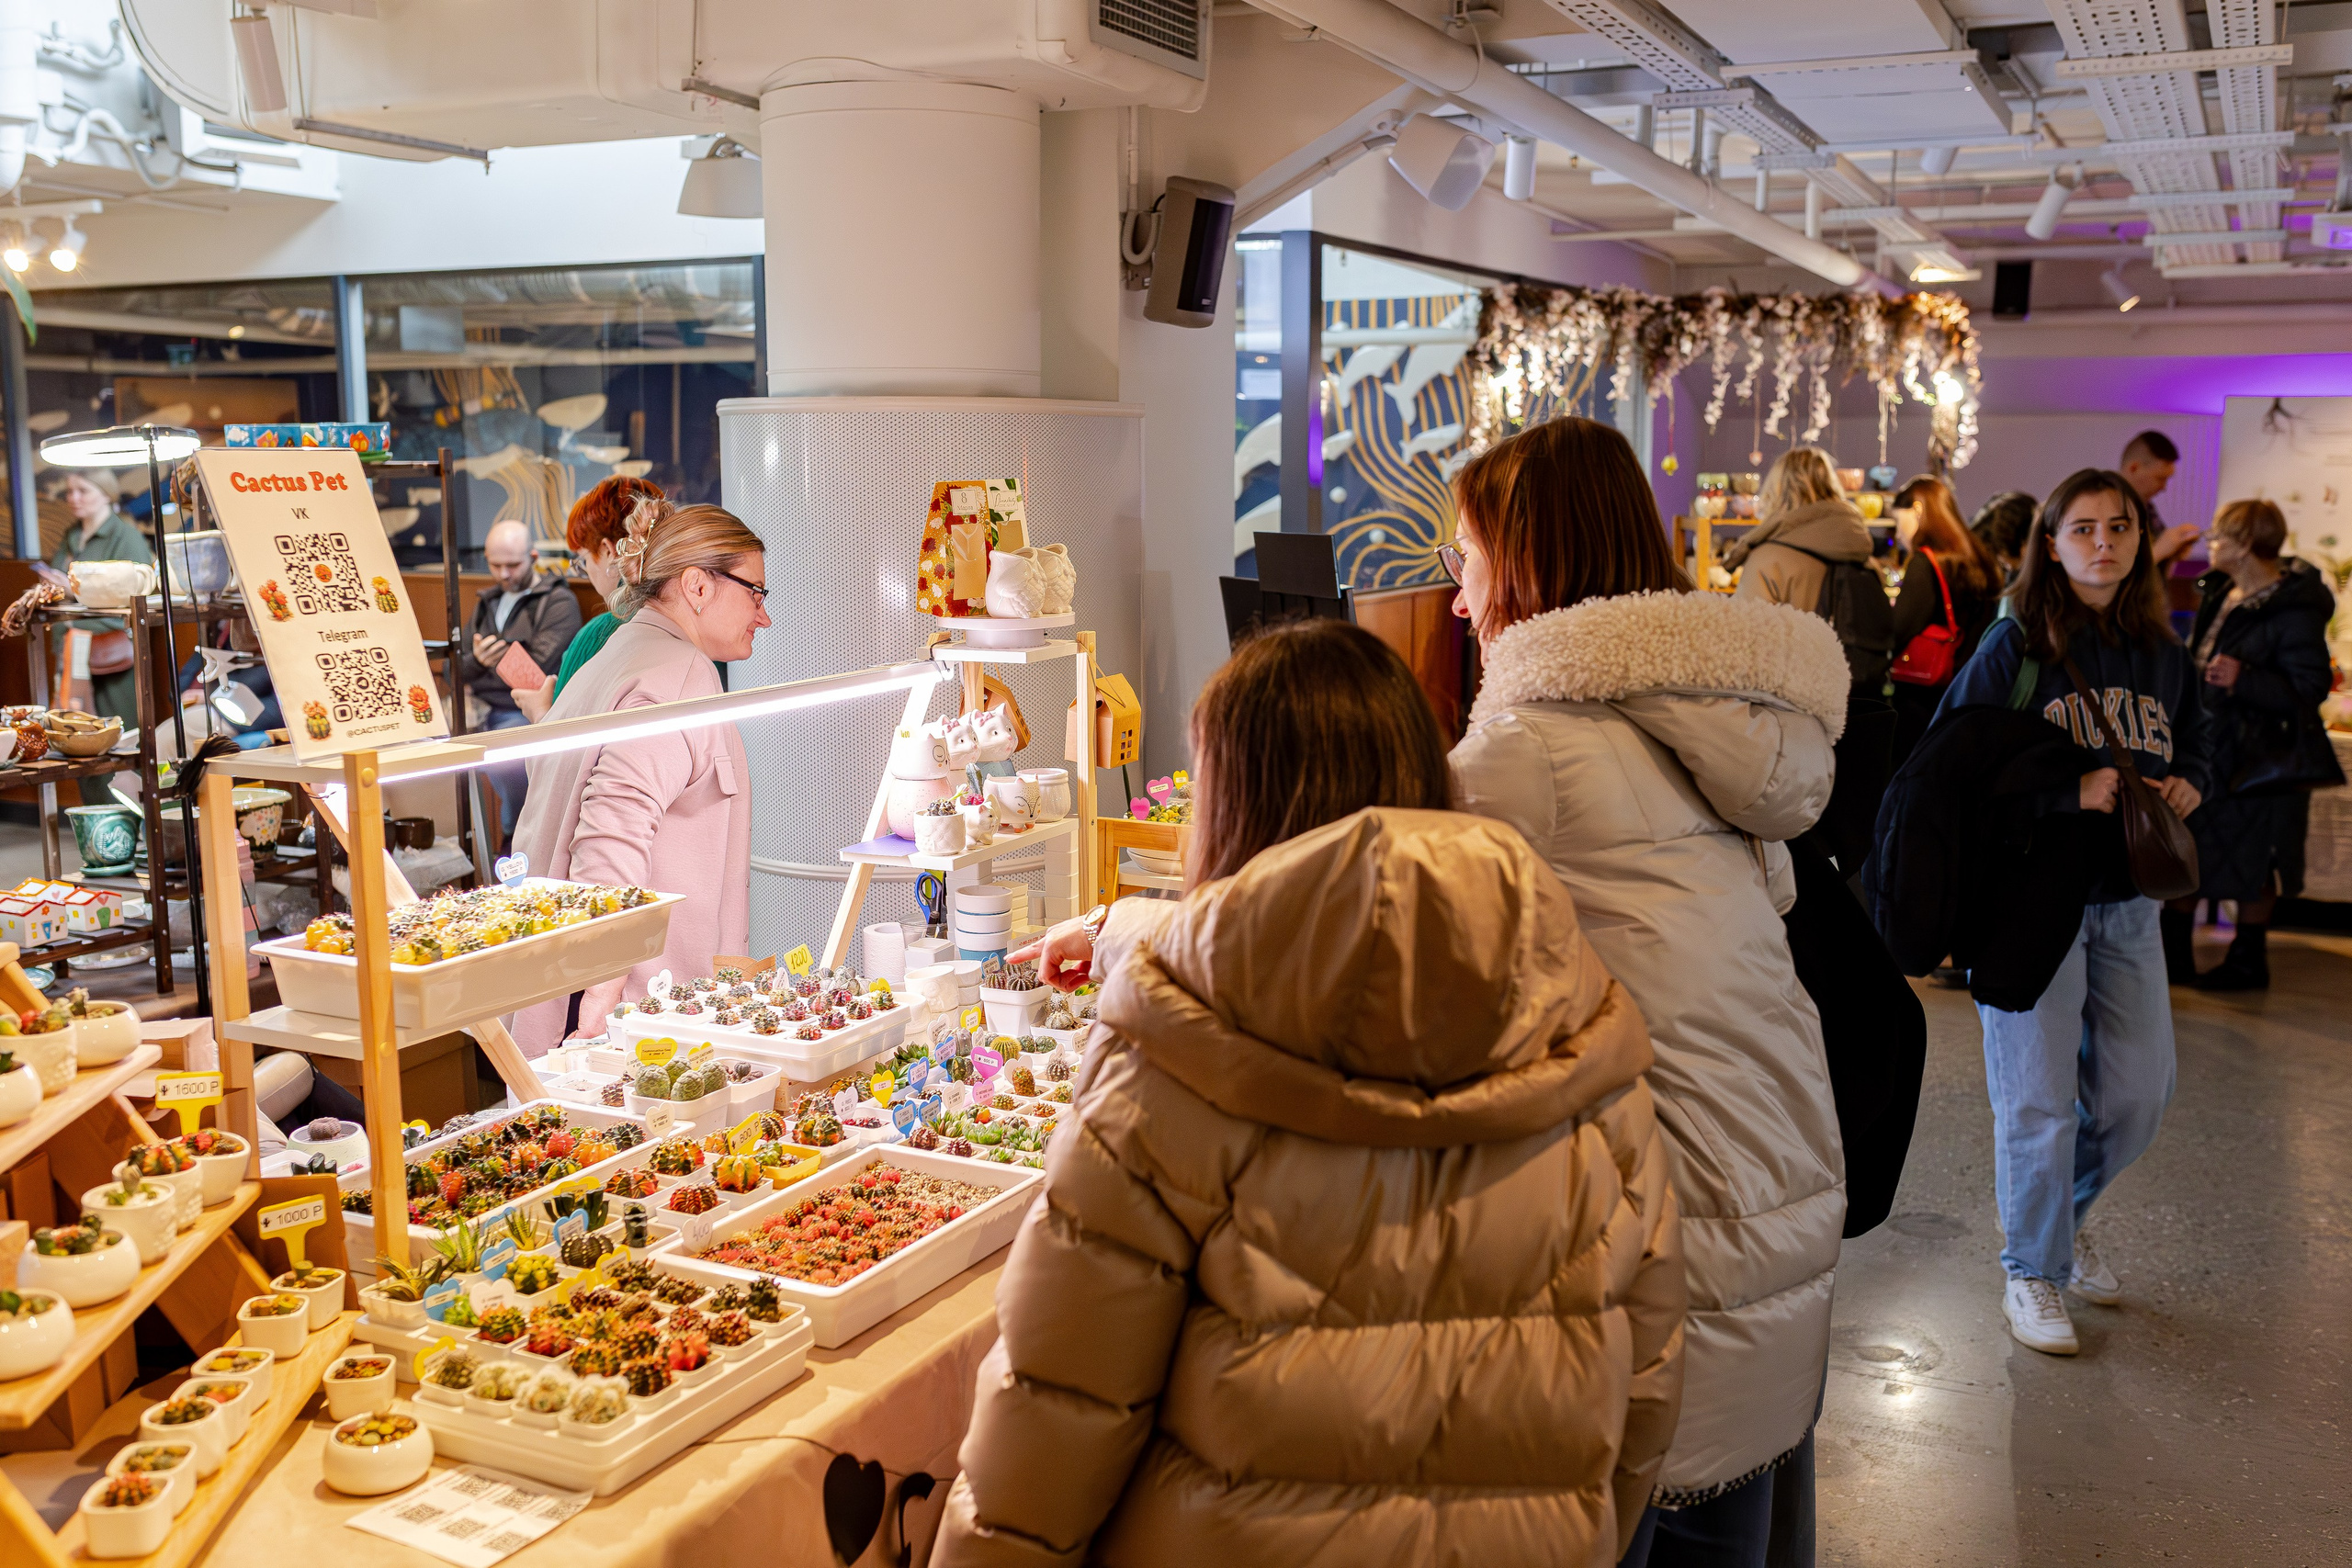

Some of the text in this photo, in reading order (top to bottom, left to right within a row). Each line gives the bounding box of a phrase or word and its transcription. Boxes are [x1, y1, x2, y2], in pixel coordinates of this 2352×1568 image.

[230, 470, 348, 492] Cactus Pet
[961, 491, 967, 503] 8
[291, 507, 310, 519] VK
[317, 628, 368, 643] Telegram
[346, 723, 401, 738] @CACTUSPET
[790, 947, 808, 970] 1200
[174, 1082, 207, 1096] 1600
[277, 1207, 309, 1225] 1000
